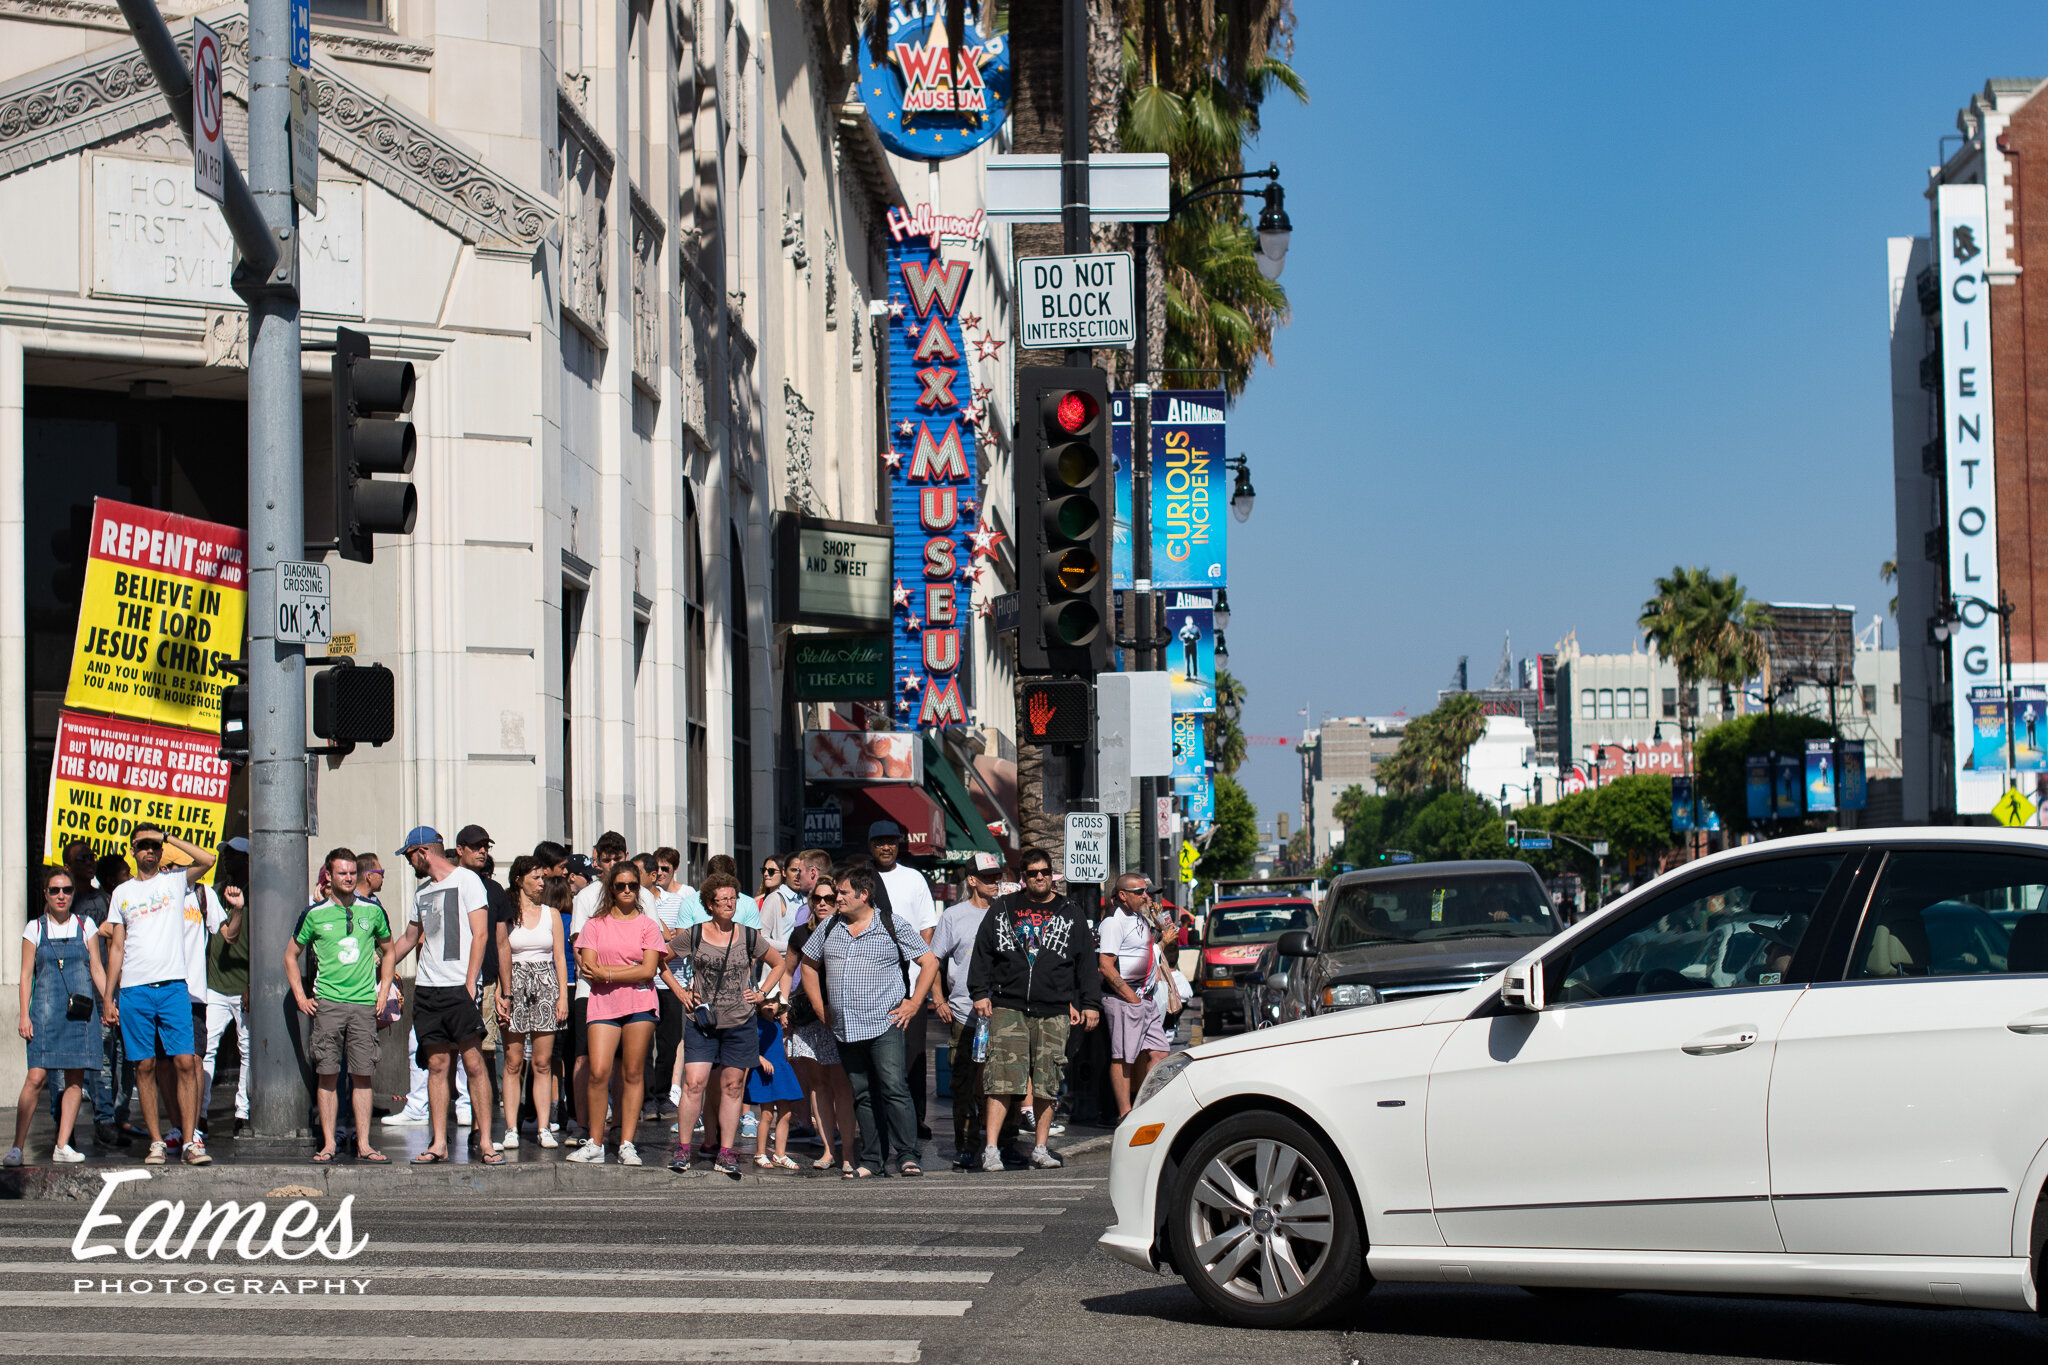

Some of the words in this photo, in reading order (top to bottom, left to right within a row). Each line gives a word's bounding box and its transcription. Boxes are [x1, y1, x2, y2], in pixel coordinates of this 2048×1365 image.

[894, 40, 986, 89] WAX
[902, 87, 987, 111] MUSEUM
[197, 149, 208, 179] ON
[209, 156, 222, 187] RED
[108, 212, 185, 246] FIRST
[887, 203, 984, 249] Hollywood
[1035, 264, 1063, 289] DO
[1075, 262, 1116, 288] NOT
[1042, 291, 1111, 318] BLOCK
[900, 257, 970, 410] WAX
[1027, 319, 1129, 340] INTERSECTION
[1167, 397, 1225, 422] AHMANSON
[1165, 431, 1190, 562] CURIOUS
[1190, 447, 1211, 544] INCIDENT
[99, 518, 198, 571] REPENT
[199, 541, 212, 557] OF
[215, 544, 243, 565] YOUR
[823, 540, 856, 558] SHORT
[195, 560, 218, 577] SINS
[219, 566, 242, 583] AND
[284, 564, 322, 579] DIAGONAL
[806, 556, 827, 573] AND
[834, 559, 868, 577] SWEET
[907, 418, 971, 727] MUSEUM
[114, 571, 193, 610] BELIEVE
[198, 589, 221, 616] IN
[283, 578, 323, 593] CROSSING
[280, 603, 299, 633] OK
[997, 594, 1019, 619] Highl
[117, 601, 151, 631] THE
[159, 610, 211, 642] LORD
[84, 626, 149, 663] JESUS
[156, 640, 233, 683] CHRIST,
[329, 646, 342, 654] KEEP
[796, 646, 838, 664] Stella
[838, 646, 883, 664] Adler
[87, 660, 111, 675] AND
[115, 665, 139, 680] YOU
[142, 670, 167, 686] WILL
[172, 676, 185, 689] BE
[808, 673, 875, 686] THEATRE
[83, 674, 104, 688] YOU
[107, 680, 129, 693] AND
[134, 684, 160, 700] YOUR
[164, 689, 222, 711] HOUSEHOLD
[101, 729, 130, 741] BELIEVES
[132, 734, 140, 742] IN
[141, 735, 153, 745] THE
[155, 738, 168, 747] SON
[170, 740, 183, 749] HAS
[184, 742, 213, 754] ETERNAL
[69, 740, 87, 754] BUT
[89, 738, 163, 767] WHOEVER
[167, 751, 229, 776] REJECTS
[60, 755, 85, 777] THE
[88, 760, 119, 783] SON
[123, 766, 168, 790] JESUS
[171, 774, 228, 798] CHRIST
[57, 808, 91, 831] FOR
[69, 788, 103, 810] WILL
[109, 795, 142, 815] NOT
[146, 801, 174, 820] SEE
[178, 805, 214, 828] LIFE,
[805, 814, 840, 829] ATM
[1072, 817, 1103, 828] CROSS
[1082, 830, 1092, 839] ON
[805, 832, 841, 842] INSIDE
[1075, 841, 1099, 851] WALK
[1070, 854, 1103, 865] SIGNAL
[1075, 867, 1098, 878] ONLY
[337, 937, 360, 965] 3
